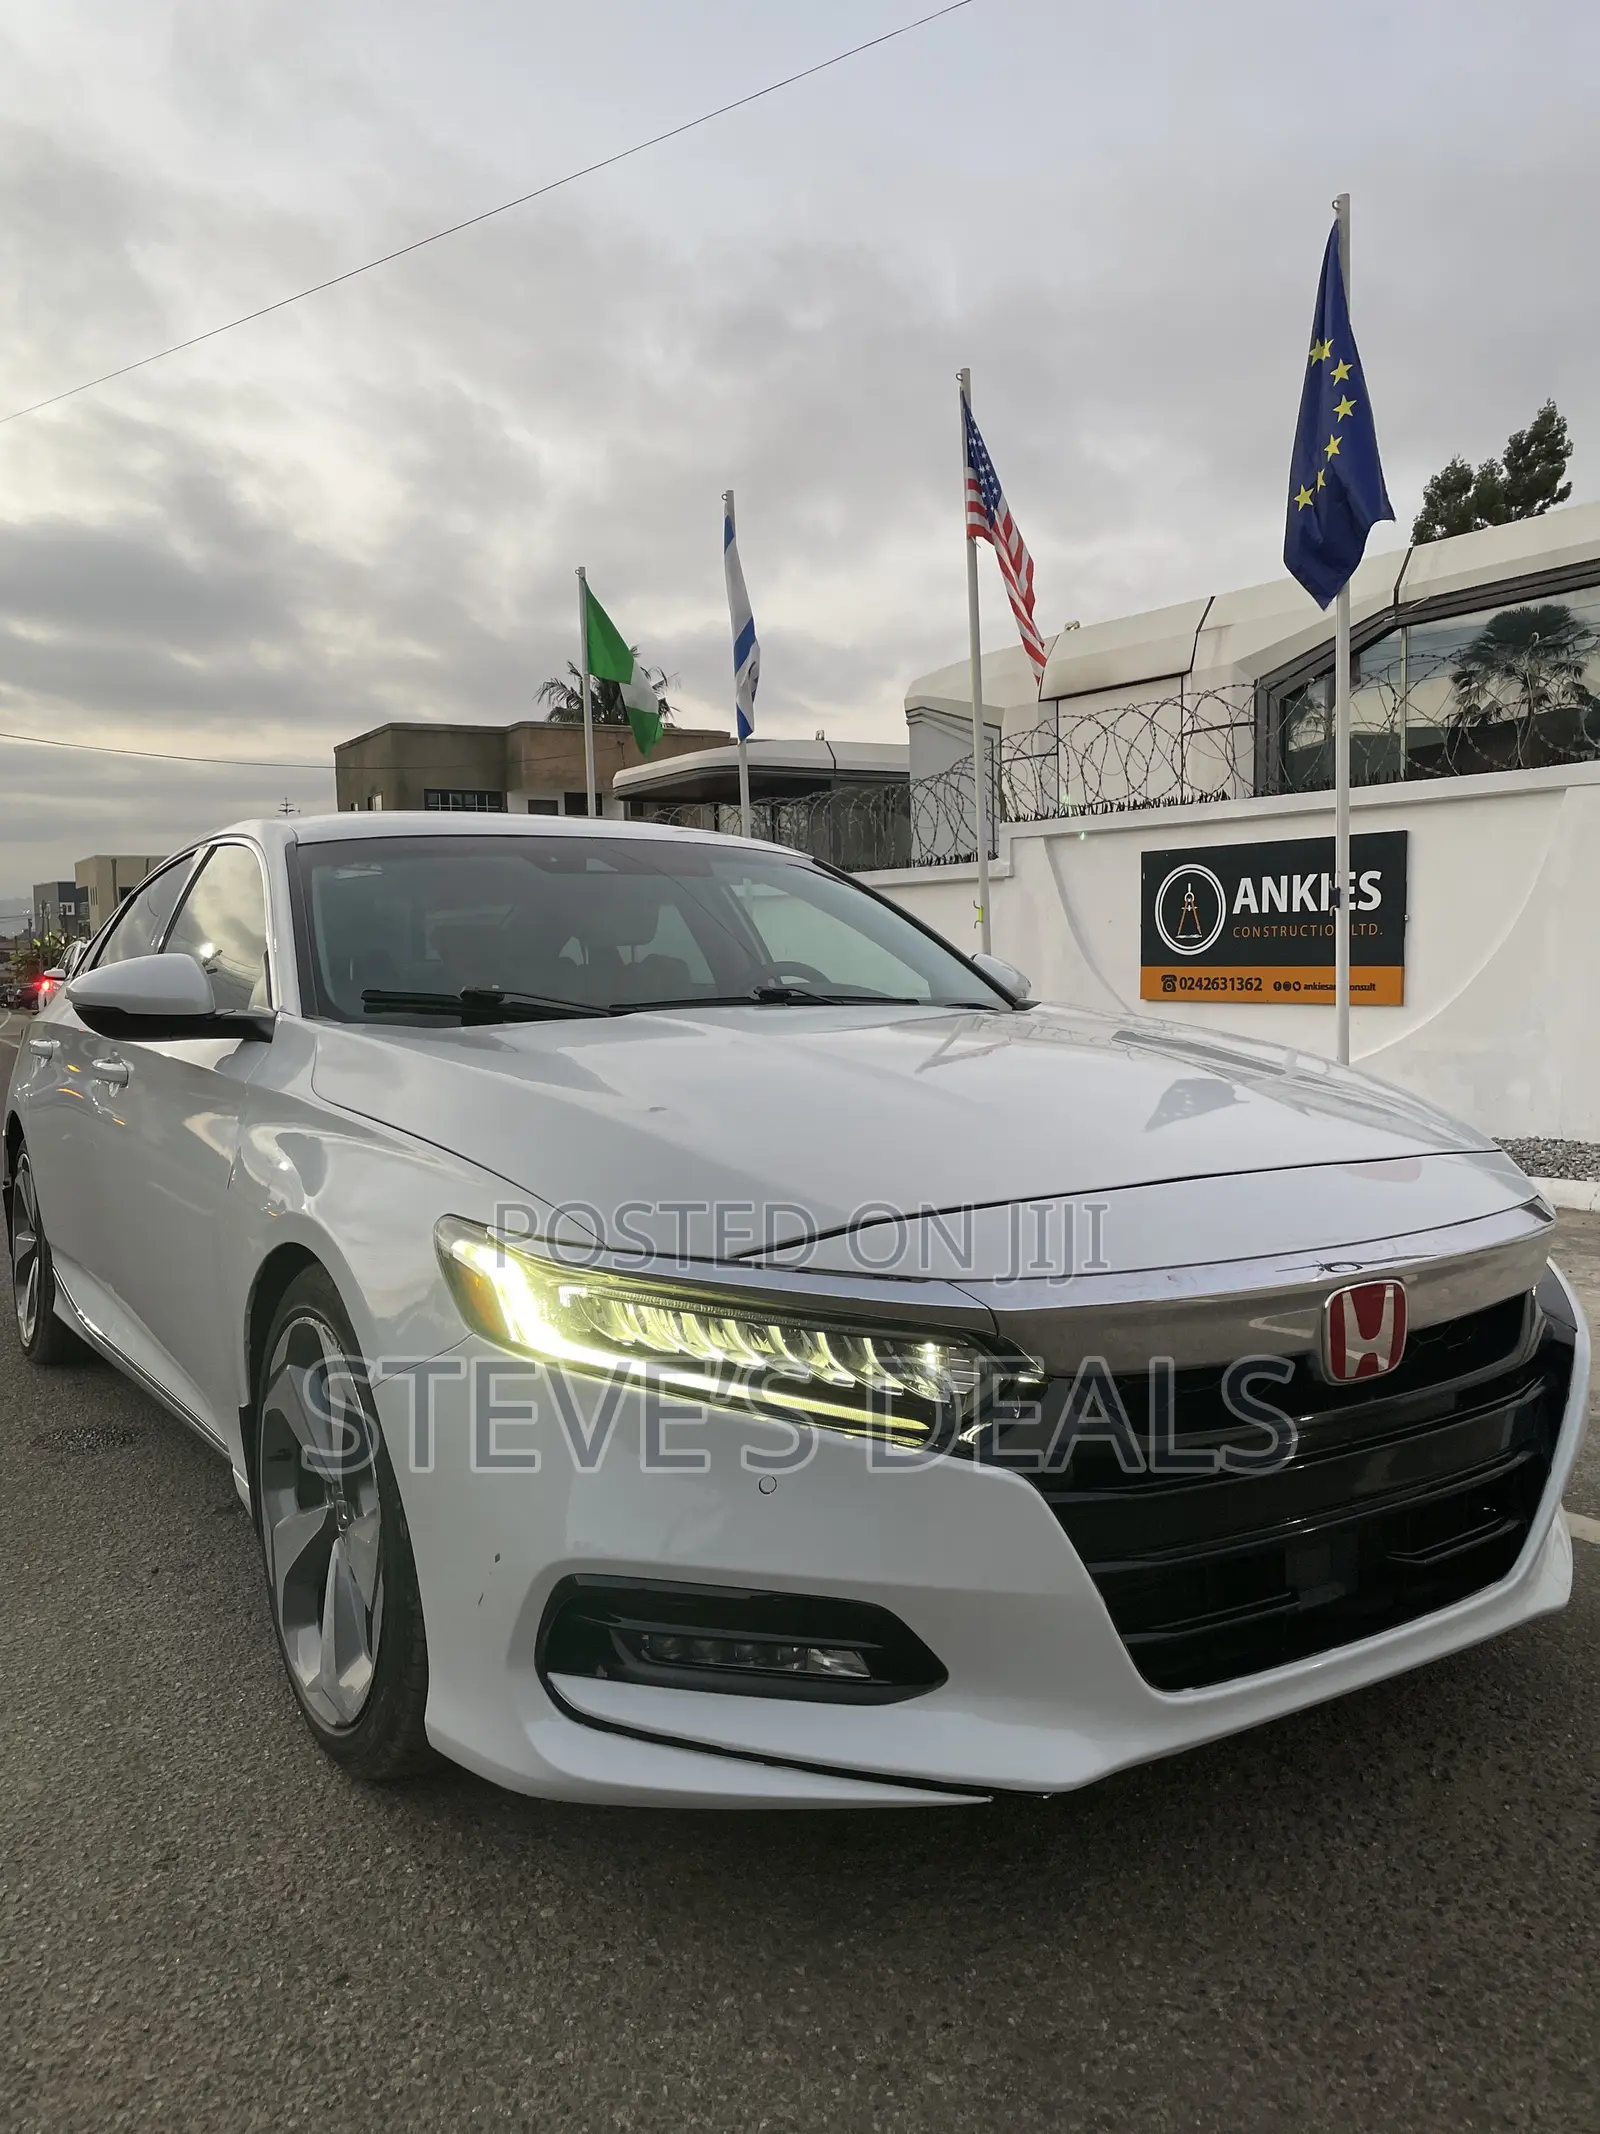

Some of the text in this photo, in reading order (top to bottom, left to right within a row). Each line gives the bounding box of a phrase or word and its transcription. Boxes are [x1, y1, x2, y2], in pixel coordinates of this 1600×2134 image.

[1232, 923, 1384, 938] CONSTRUCTIO LTD.
[1179, 976, 1263, 992] 0242631362
